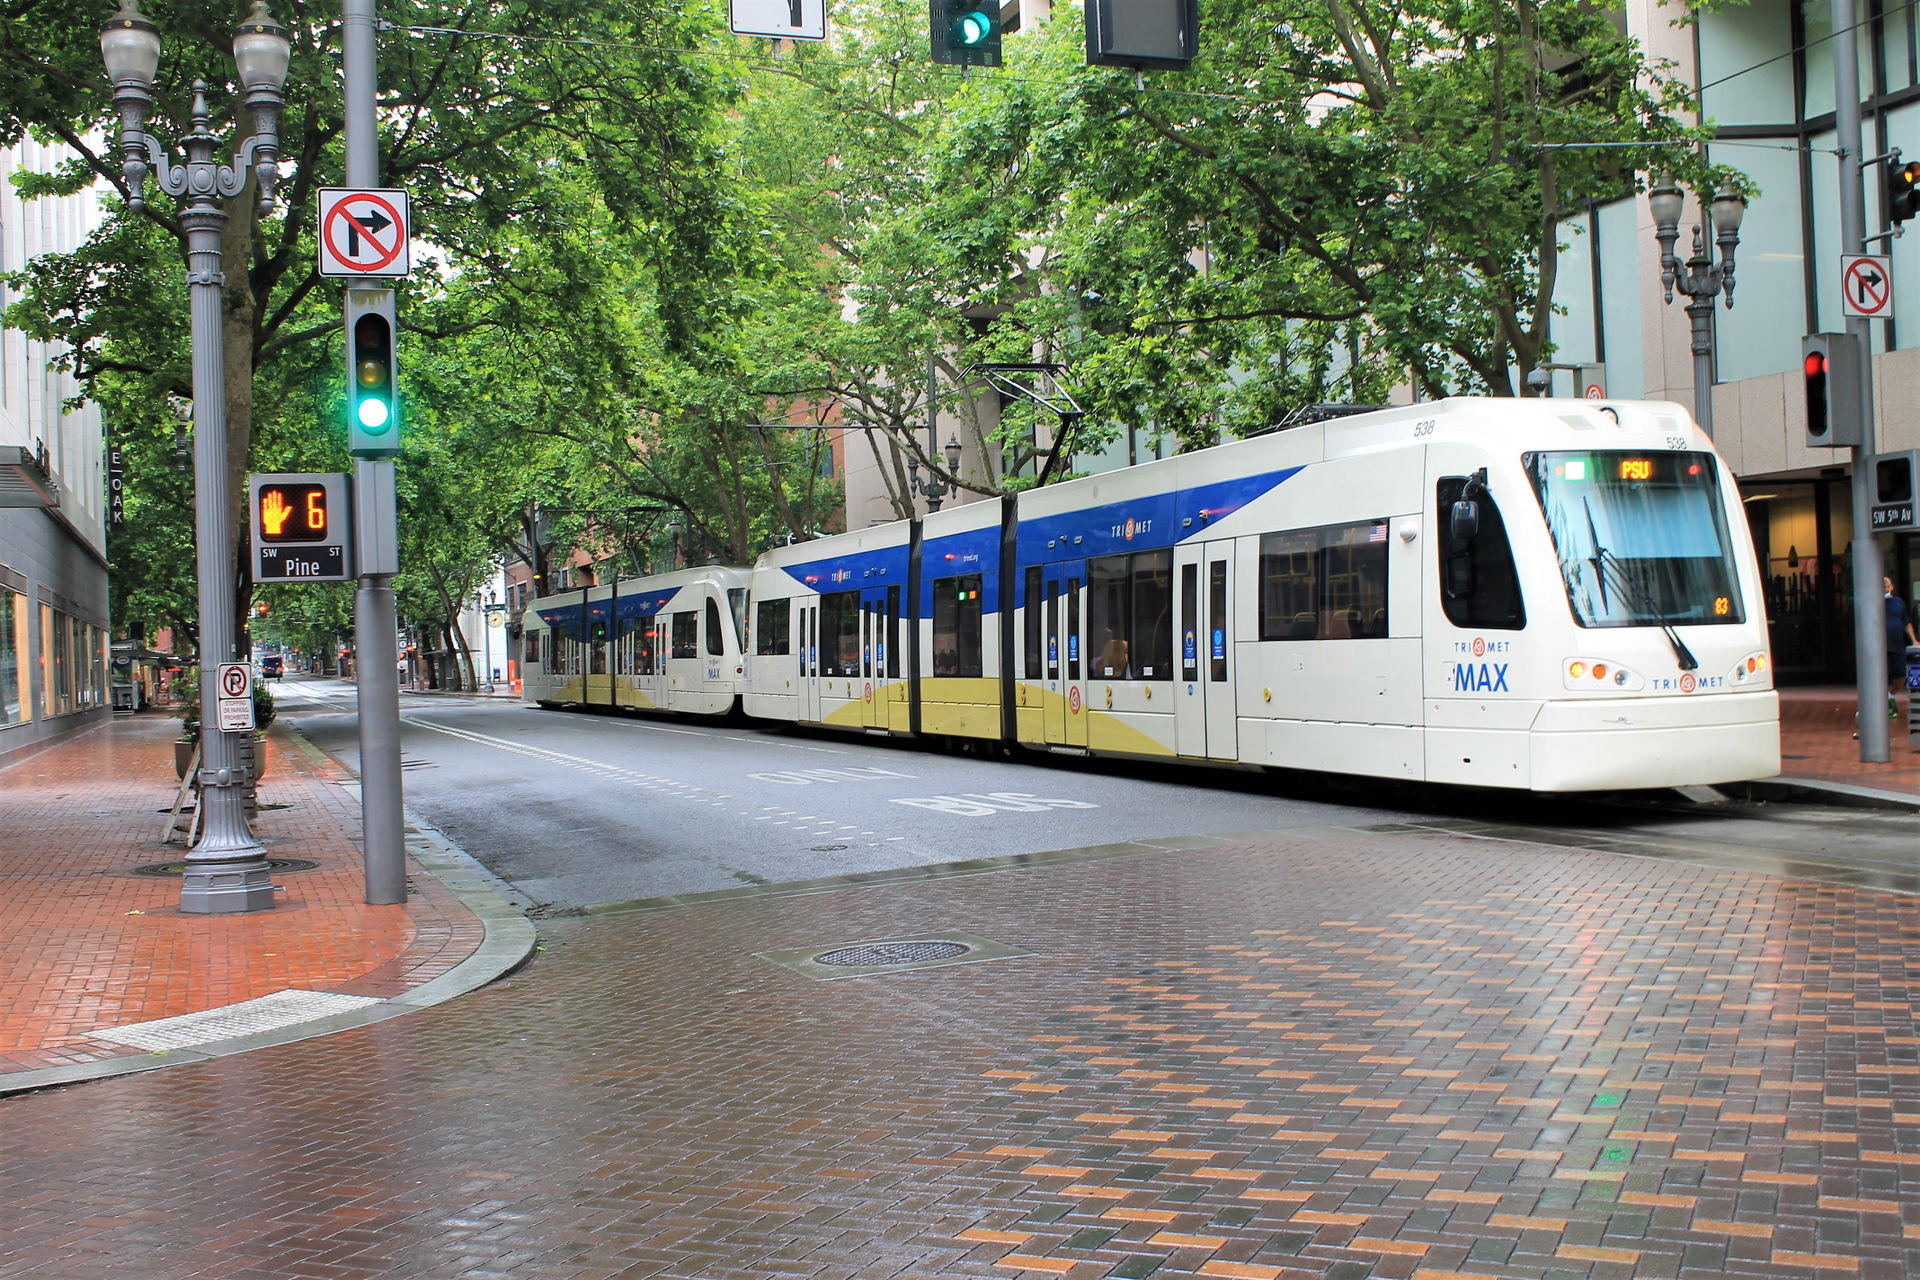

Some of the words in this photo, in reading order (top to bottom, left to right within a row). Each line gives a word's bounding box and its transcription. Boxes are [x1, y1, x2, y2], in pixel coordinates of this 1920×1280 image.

[1414, 419, 1436, 437] 538
[1666, 436, 1688, 450] 538
[1621, 460, 1650, 480] PSU
[307, 491, 325, 530] 6
[1873, 510, 1886, 525] SW
[1887, 508, 1899, 523] 5th
[262, 548, 278, 558] SW
[329, 547, 340, 557] ST
[286, 558, 320, 577] Pine
[1715, 597, 1729, 615] 83
[1455, 663, 1509, 692] MAX
[746, 768, 920, 785] ONLY
[888, 792, 1101, 817] BUS
